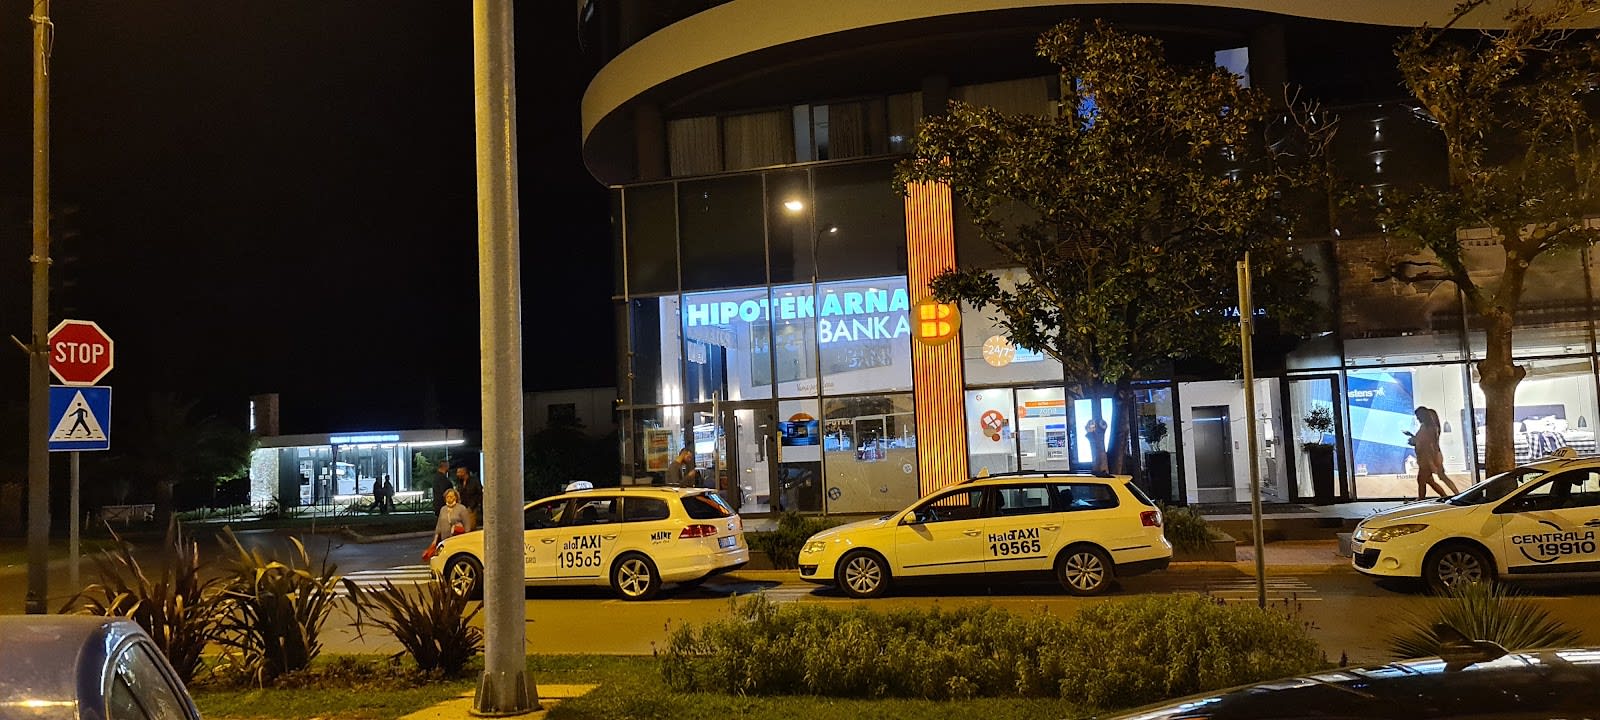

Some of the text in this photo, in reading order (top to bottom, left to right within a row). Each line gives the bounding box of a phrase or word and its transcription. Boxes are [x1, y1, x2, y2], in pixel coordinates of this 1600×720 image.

[687, 288, 909, 327] HIPOTEKARNA
[820, 315, 910, 343] BANKA
[55, 341, 105, 364] STOP
[988, 344, 1010, 358] 24/7
[1512, 531, 1595, 545] CENTRALA
[990, 540, 1041, 557] 19565
[1537, 541, 1596, 556] 19910
